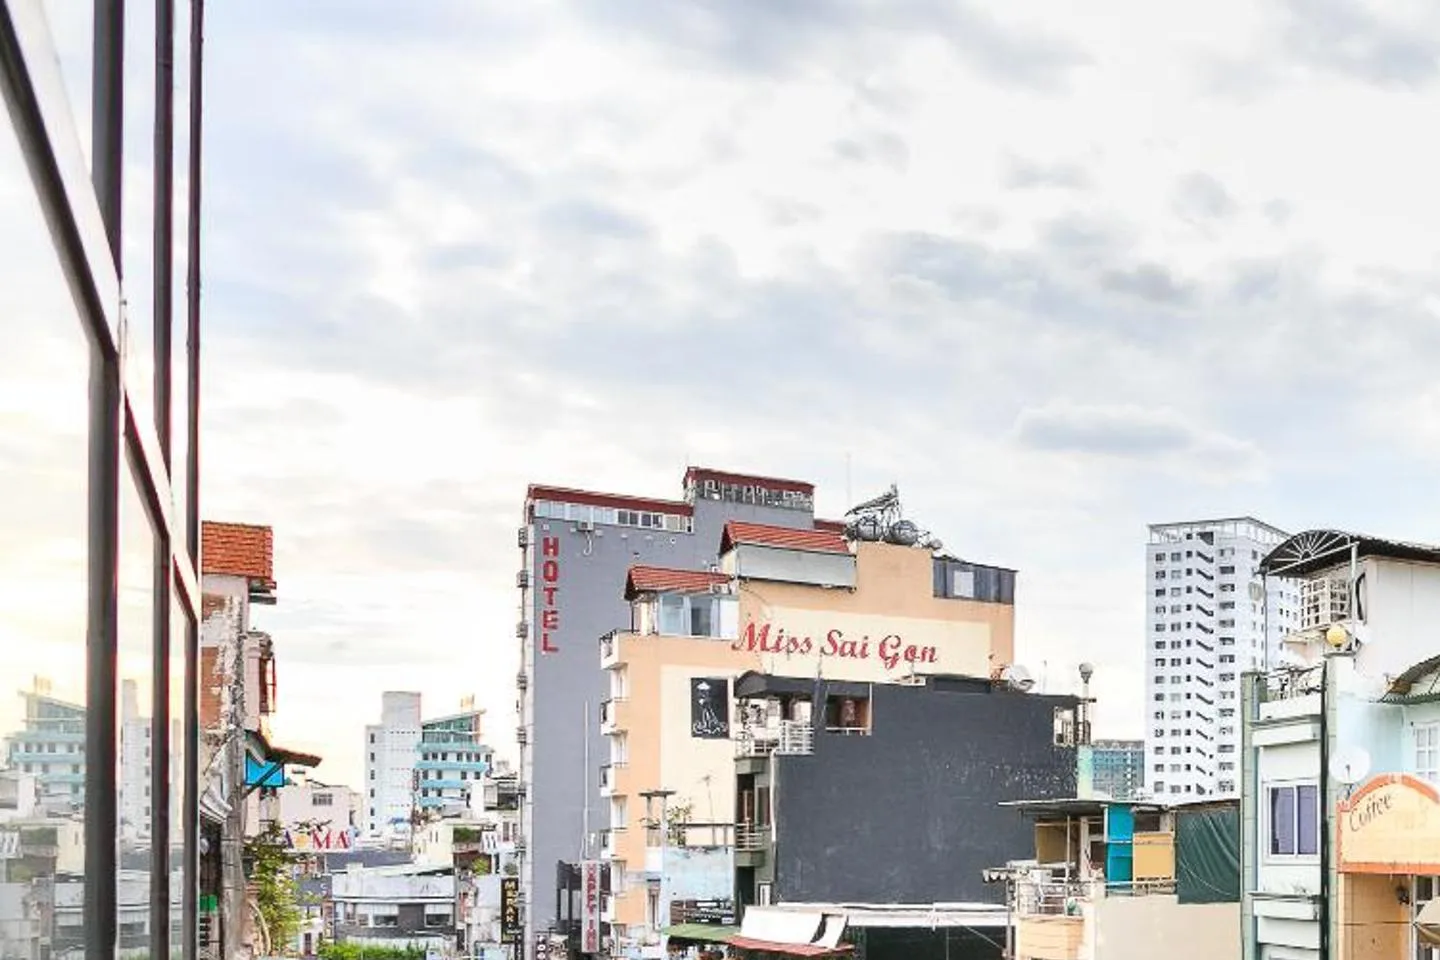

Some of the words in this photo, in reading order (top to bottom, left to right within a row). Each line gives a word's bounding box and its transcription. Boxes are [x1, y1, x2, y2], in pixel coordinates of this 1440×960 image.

[542, 537, 558, 653] HOTEL
[732, 617, 812, 655] Miss
[821, 630, 870, 659] Sai
[879, 634, 939, 669] Gon
